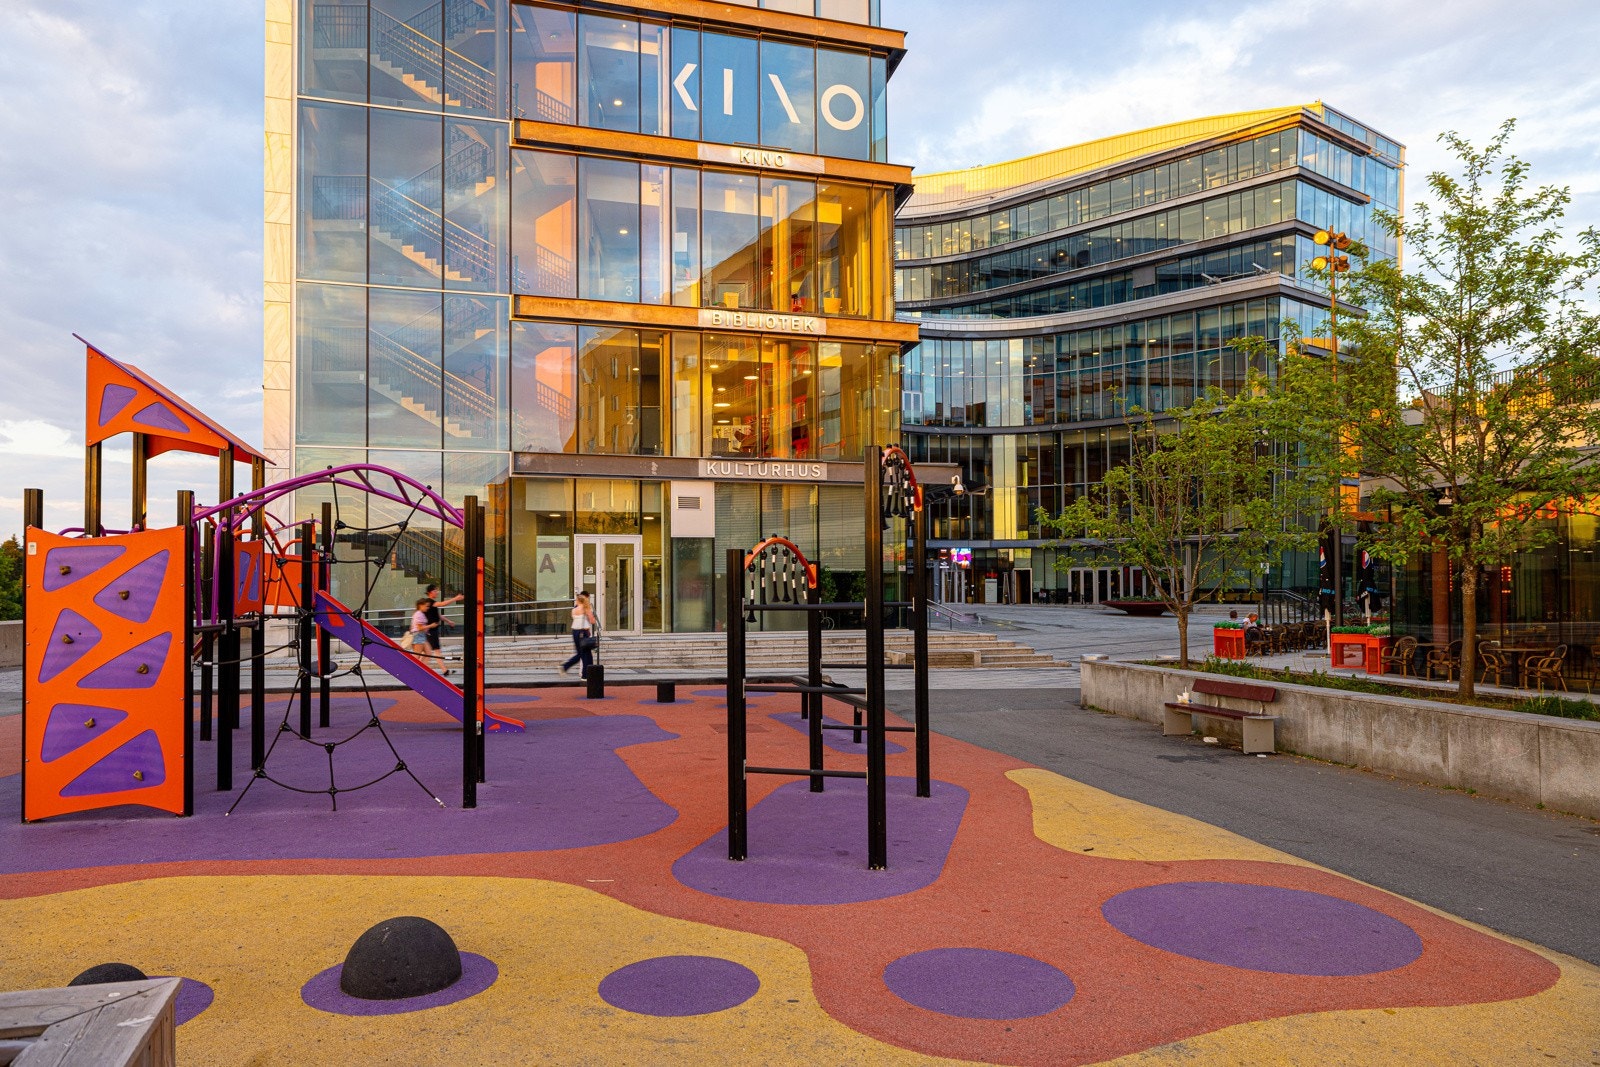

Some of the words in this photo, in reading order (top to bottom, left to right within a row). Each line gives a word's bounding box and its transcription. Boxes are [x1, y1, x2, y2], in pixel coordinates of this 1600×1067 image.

[739, 150, 786, 168] KINO
[625, 285, 633, 297] 3
[712, 312, 814, 332] BIBLIOTEK
[626, 413, 634, 425] 2
[707, 461, 821, 478] KULTURHUS
[539, 553, 556, 573] A
